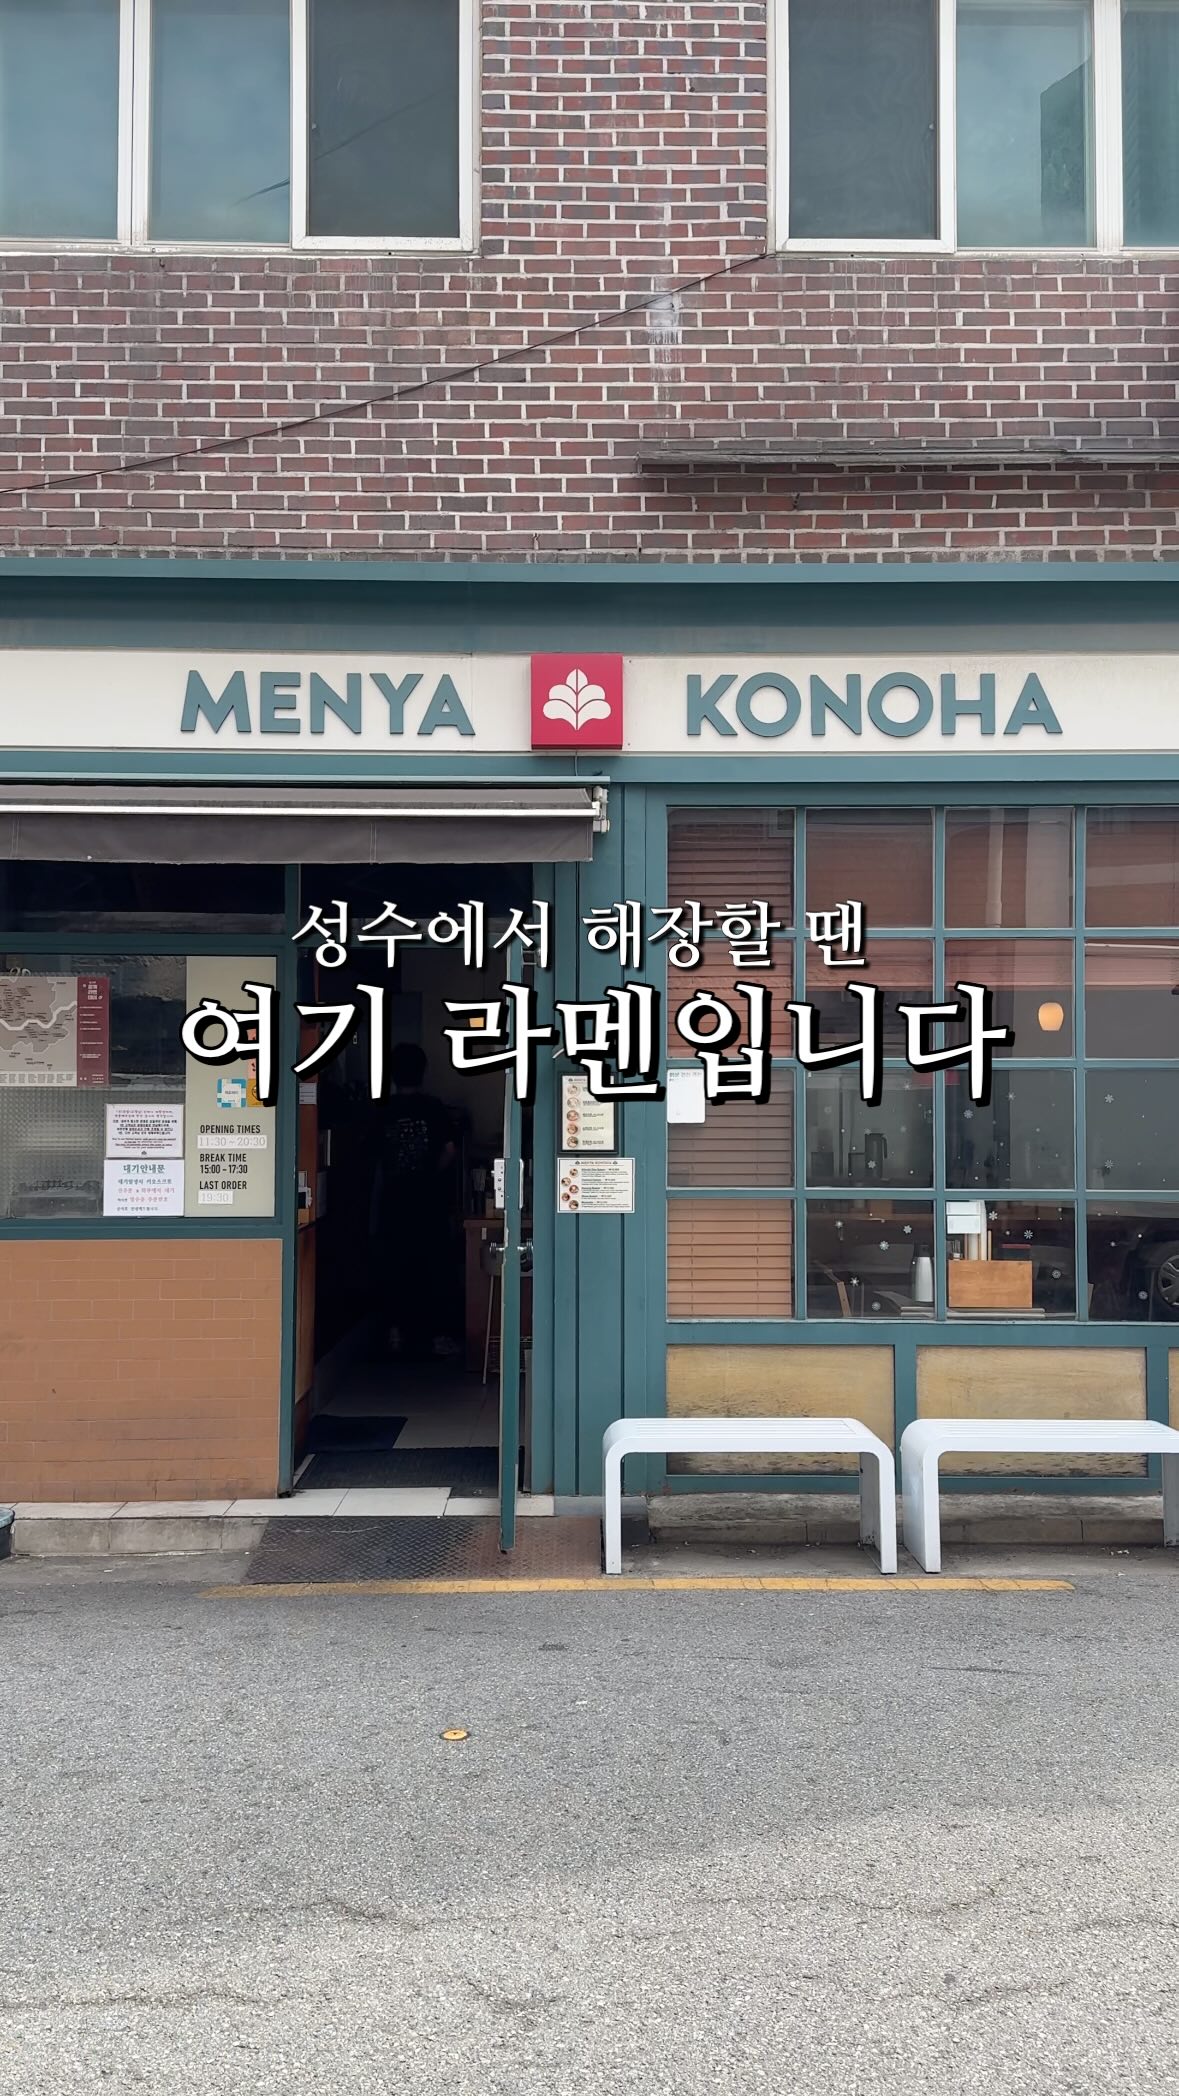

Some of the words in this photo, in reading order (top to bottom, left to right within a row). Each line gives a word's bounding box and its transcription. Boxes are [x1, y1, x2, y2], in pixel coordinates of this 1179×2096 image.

[180, 670, 475, 736] MENYA
[685, 672, 1063, 738] KONOHA
[199, 1124, 235, 1134] OPENING
[237, 1124, 261, 1134] TIMES
[199, 1137, 227, 1147] 11:30
[237, 1137, 266, 1147] 20:30
[199, 1153, 226, 1163] BREAK
[228, 1153, 247, 1163] TIME
[123, 1164, 166, 1174] 대기안내문
[200, 1164, 221, 1174] 15:00
[228, 1164, 248, 1174] 17:30
[199, 1180, 219, 1190] LAST
[221, 1180, 247, 1190] ORDER
[202, 1193, 229, 1203] 19:30
